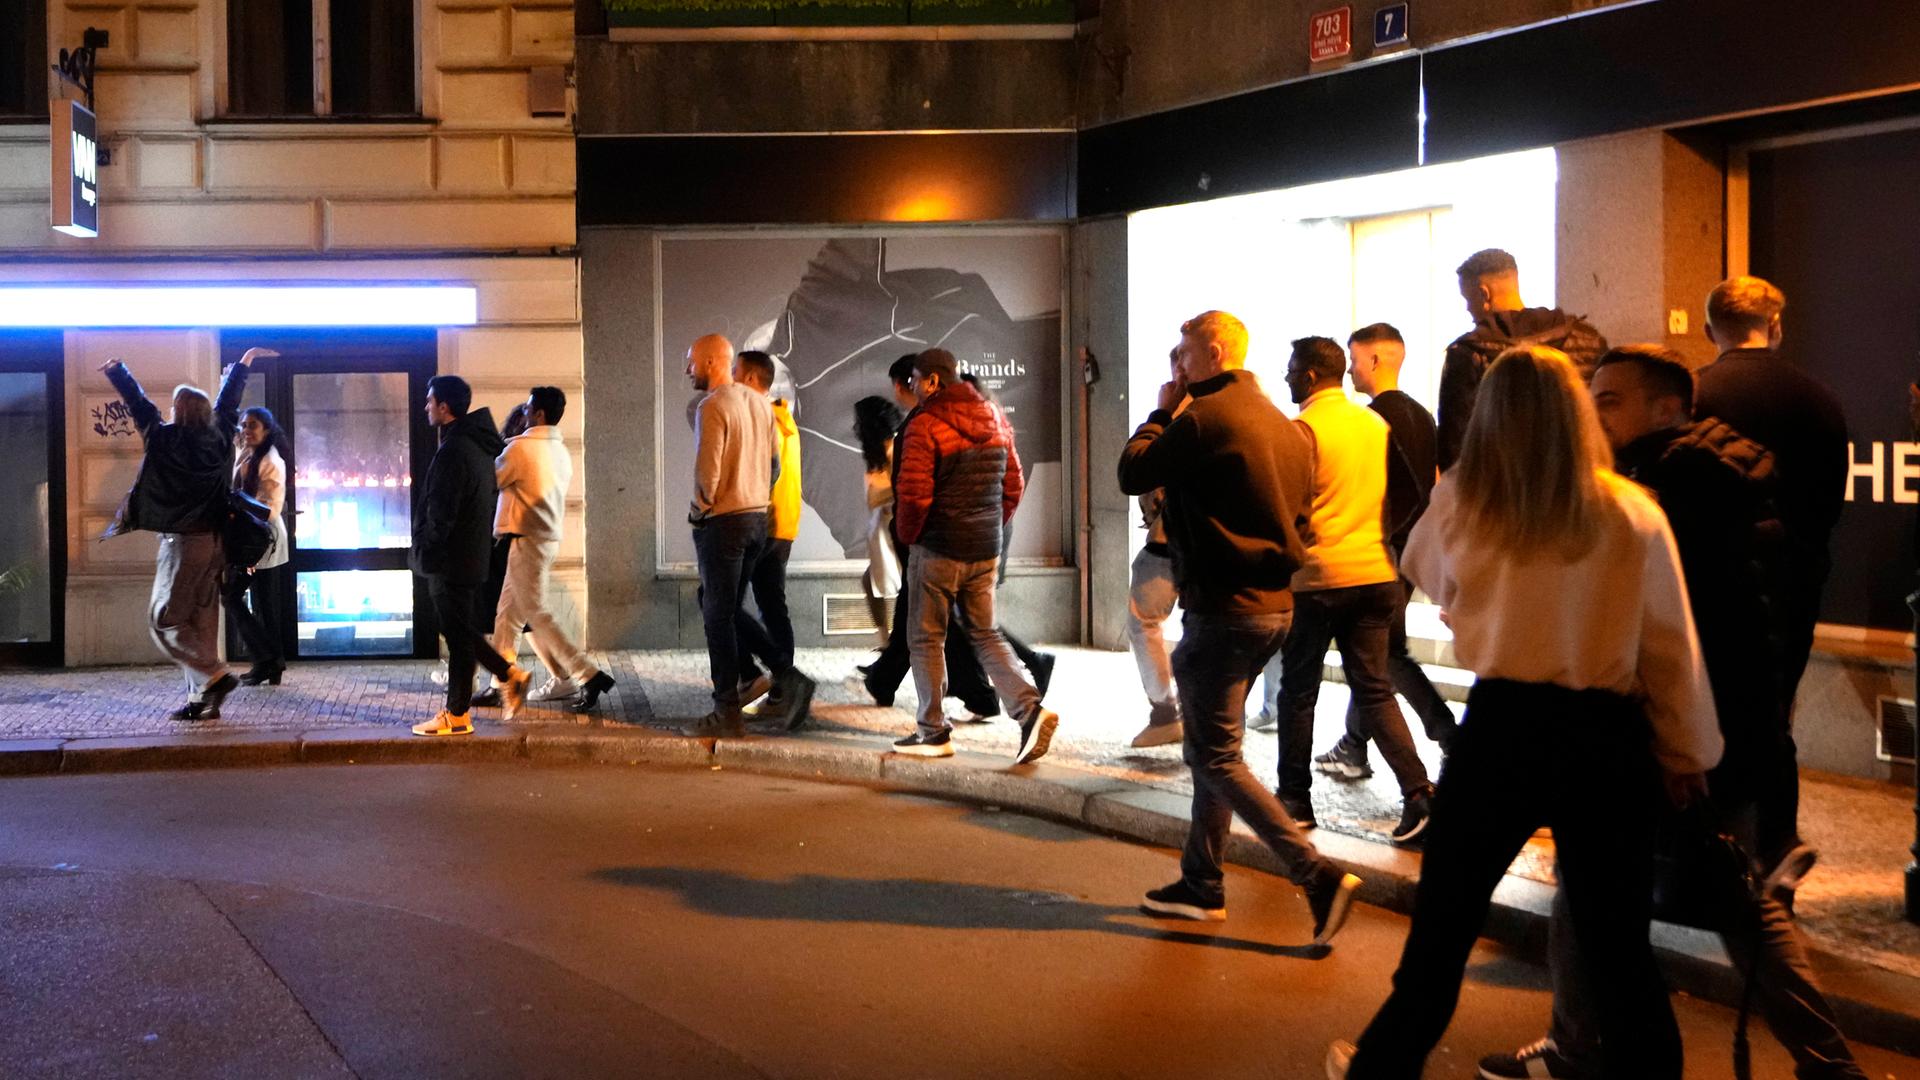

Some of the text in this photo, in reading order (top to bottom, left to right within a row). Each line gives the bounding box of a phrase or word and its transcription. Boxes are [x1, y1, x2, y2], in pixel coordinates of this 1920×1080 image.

[1316, 14, 1340, 38] 703
[1385, 13, 1394, 36] 7
[956, 358, 1026, 377] Brands
